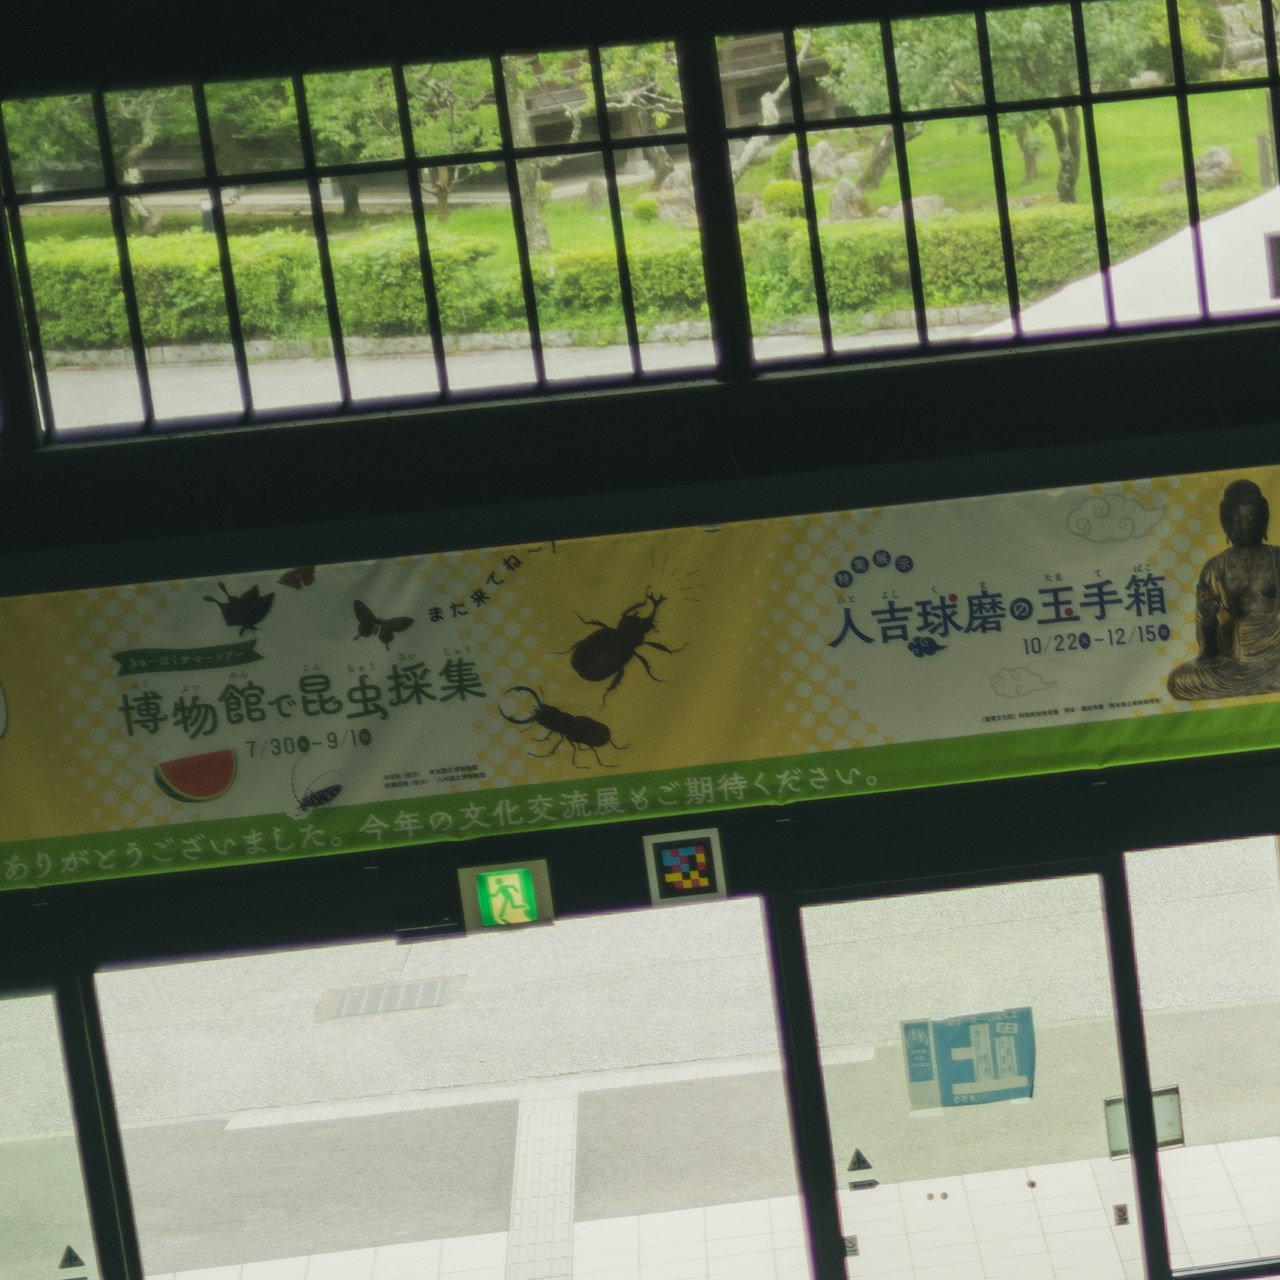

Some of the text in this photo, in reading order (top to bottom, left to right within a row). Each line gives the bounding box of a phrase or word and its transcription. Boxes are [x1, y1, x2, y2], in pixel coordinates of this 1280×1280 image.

[827, 572, 1169, 648] 人吉球磨の玉手箱
[118, 657, 487, 740] 博物館で昆虫採集
